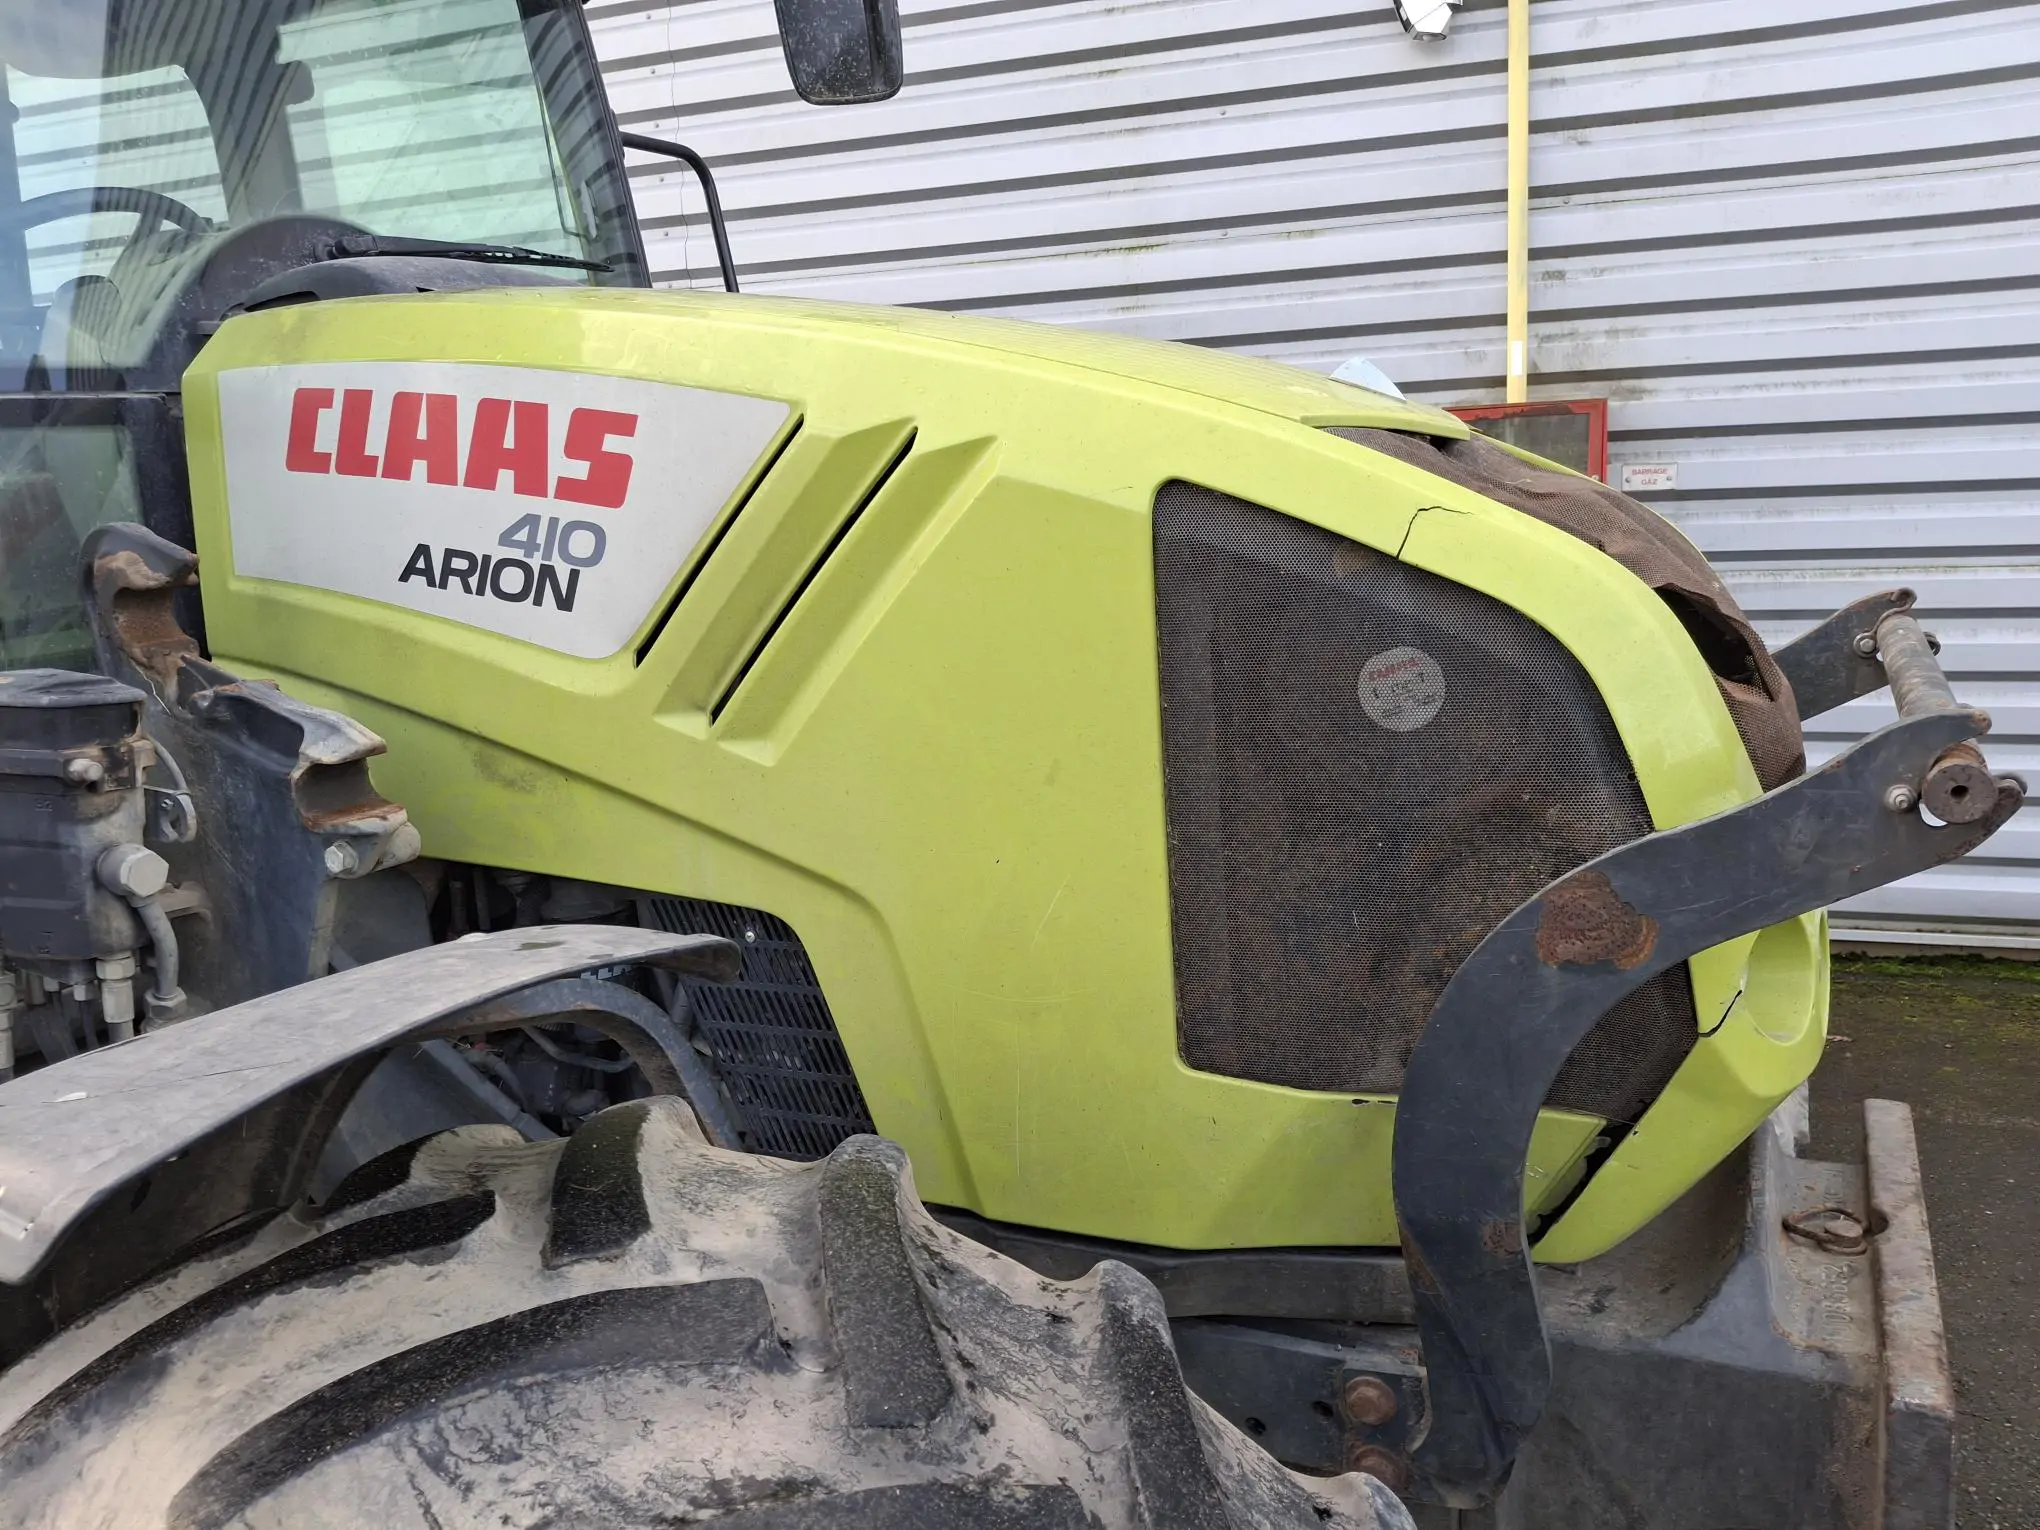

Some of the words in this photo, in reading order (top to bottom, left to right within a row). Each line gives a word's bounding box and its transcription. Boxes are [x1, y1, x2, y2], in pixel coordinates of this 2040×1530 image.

[285, 387, 639, 509] CLAAS
[1631, 468, 1668, 476] BARRAGE
[1641, 477, 1658, 486] GAZ
[497, 512, 607, 569] 410
[398, 542, 581, 613] ARION
